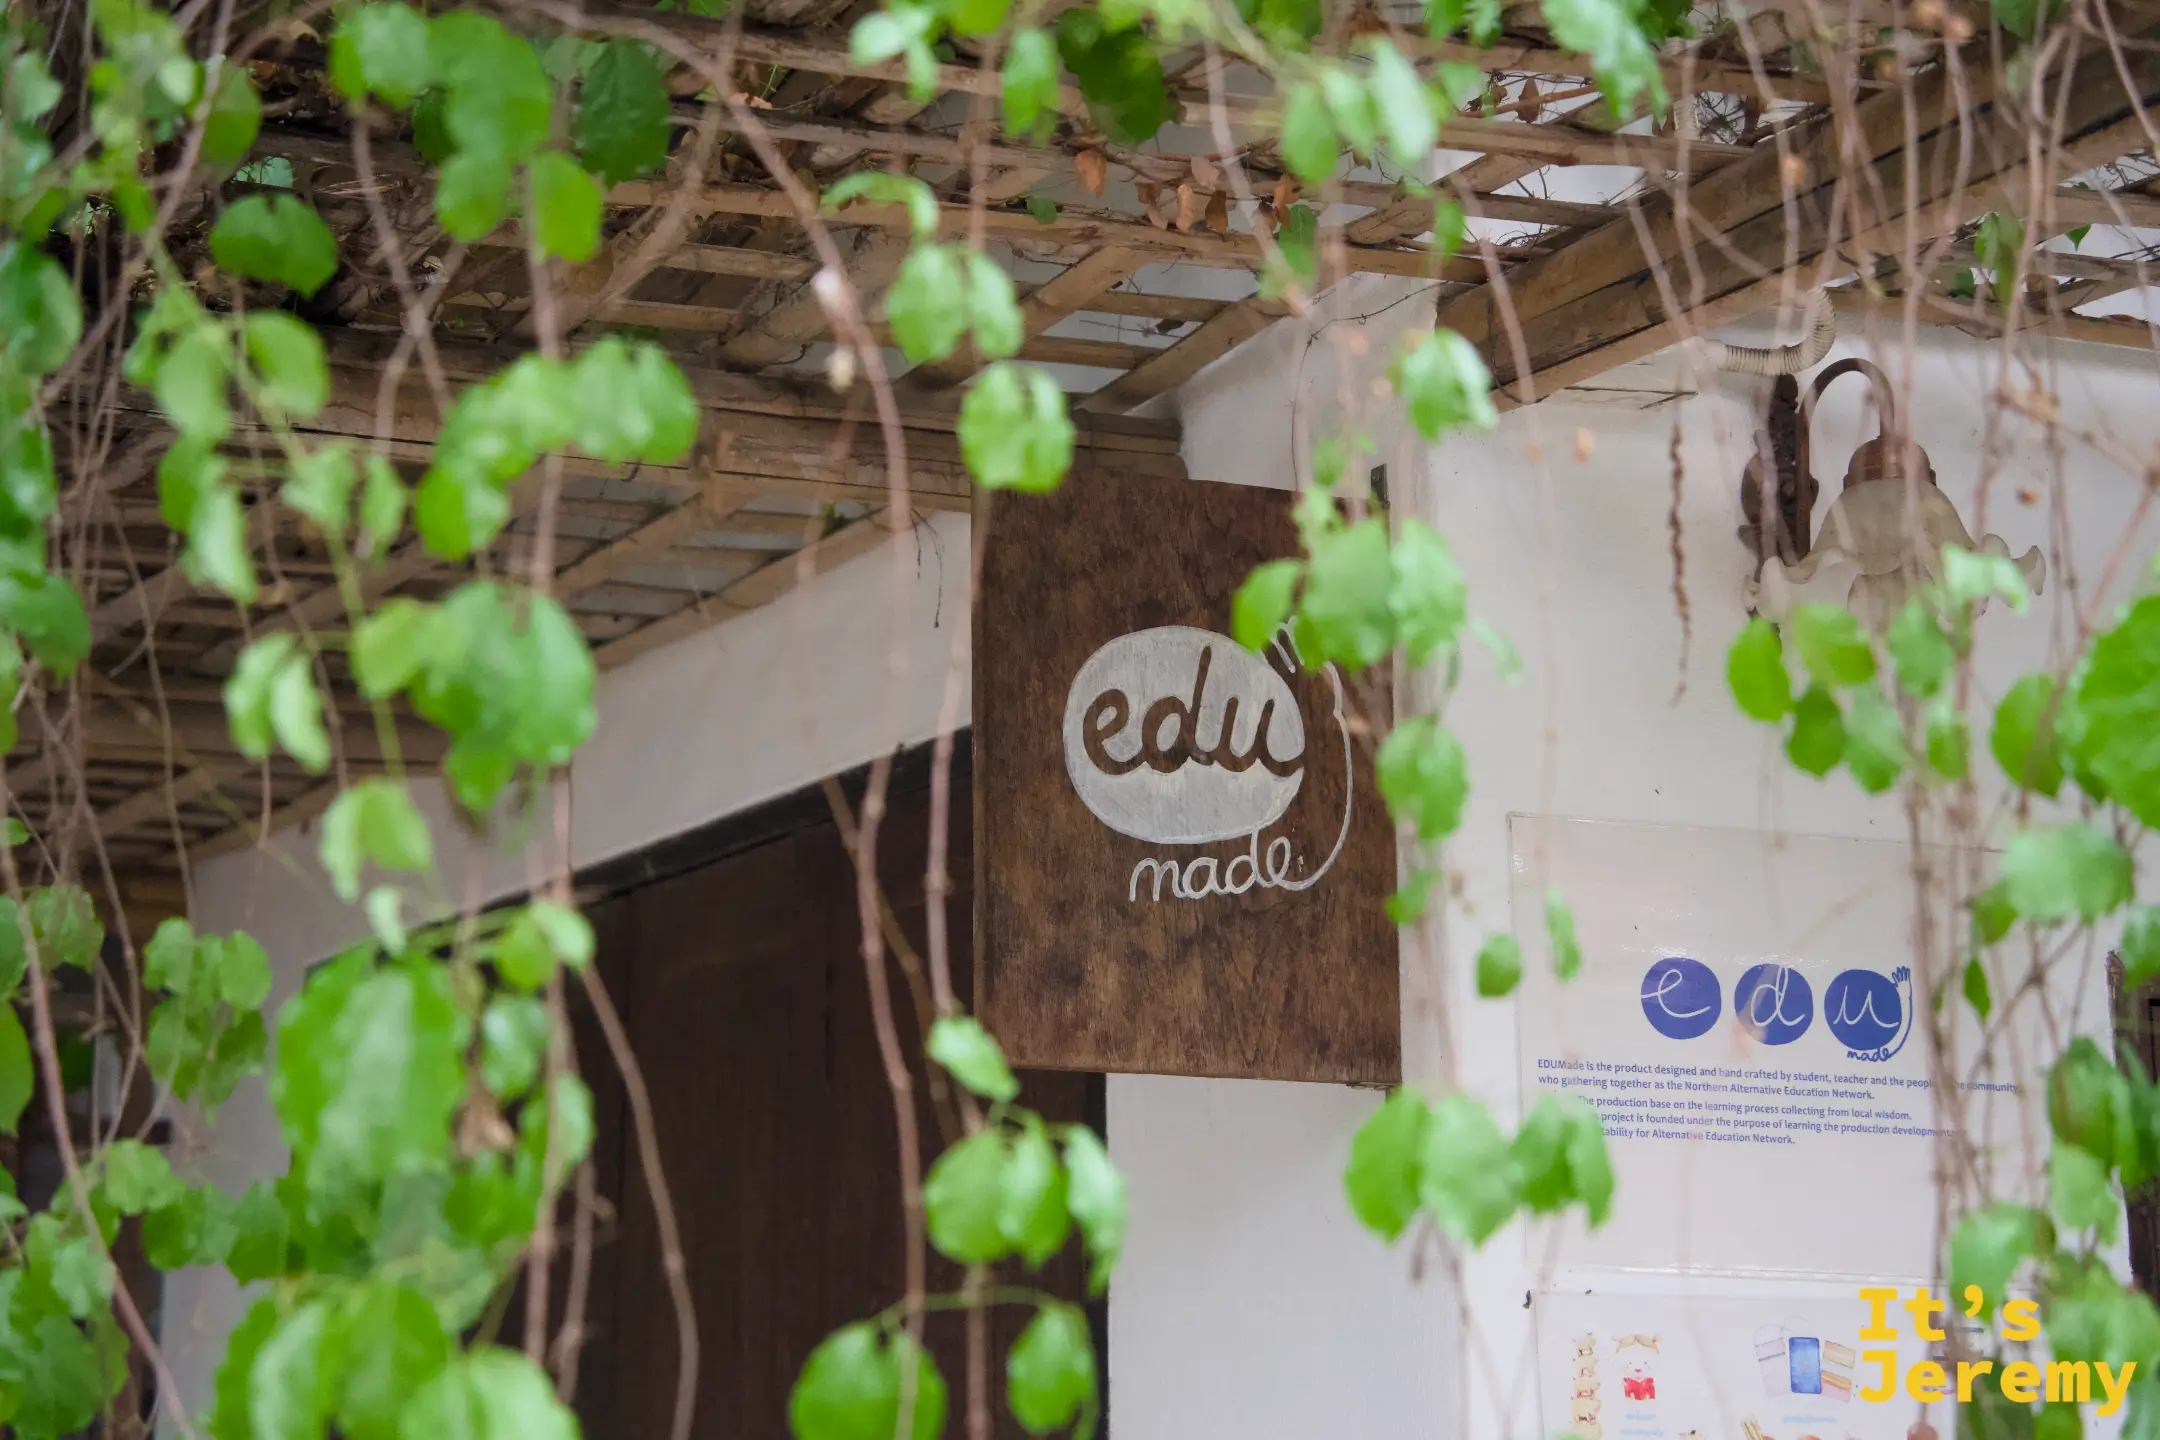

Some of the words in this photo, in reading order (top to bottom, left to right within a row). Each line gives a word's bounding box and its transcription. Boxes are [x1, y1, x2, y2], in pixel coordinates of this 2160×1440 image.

[1082, 645, 1304, 778] edu
[1130, 828, 1297, 901] made
[1846, 1048, 1892, 1063] made
[1538, 1059, 1584, 1071] EDUMade
[1586, 1061, 1594, 1071] is
[1596, 1062, 1612, 1072] the
[1614, 1063, 1652, 1076] product
[1654, 1064, 1696, 1078] designed
[1699, 1067, 1717, 1077] and
[1718, 1068, 1742, 1078] hand
[1744, 1069, 1778, 1080] crafted
[1780, 1070, 1791, 1083] by
[1793, 1071, 1831, 1084] student,
[1834, 1074, 1868, 1084] teacher
[1870, 1075, 1887, 1085] and
[1889, 1076, 1904, 1086] the
[1907, 1077, 1933, 1089] peopl
[1538, 1074, 1559, 1085] who
[1561, 1076, 1608, 1089] gathering
[1610, 1079, 1651, 1090] together
[1654, 1081, 1665, 1090] as
[1667, 1080, 1682, 1090] the
[1684, 1081, 1728, 1092] Northern
[1730, 1083, 1782, 1095] Alternative
[1784, 1087, 1829, 1097] Education
[1832, 1089, 1875, 1100] Network.
[1596, 1097, 1648, 1108] production
[1650, 1098, 1671, 1109] base
[1673, 1101, 1685, 1110] on
[1687, 1100, 1703, 1110] the
[1704, 1102, 1742, 1114] learning
[1744, 1104, 1779, 1115] process
[1781, 1105, 1825, 1118] collecting
[1827, 1107, 1849, 1117] from
[1852, 1108, 1873, 1118] local
[1874, 1109, 1912, 1120] wisdom.
[1601, 1112, 1634, 1124] project
[1636, 1113, 1644, 1123] is
[1646, 1113, 1685, 1125] founded
[1686, 1115, 1713, 1126] under
[1716, 1117, 1731, 1127] the
[1733, 1119, 1770, 1130] purpose
[1773, 1119, 1783, 1129] of
[1785, 1120, 1821, 1133] learning
[1824, 1121, 1839, 1132] the
[1841, 1123, 1890, 1135] production
[1636, 1128, 1650, 1138] for
[1652, 1129, 1703, 1140] Alternative
[1705, 1132, 1750, 1142] Education
[1753, 1134, 1795, 1145] Network.
